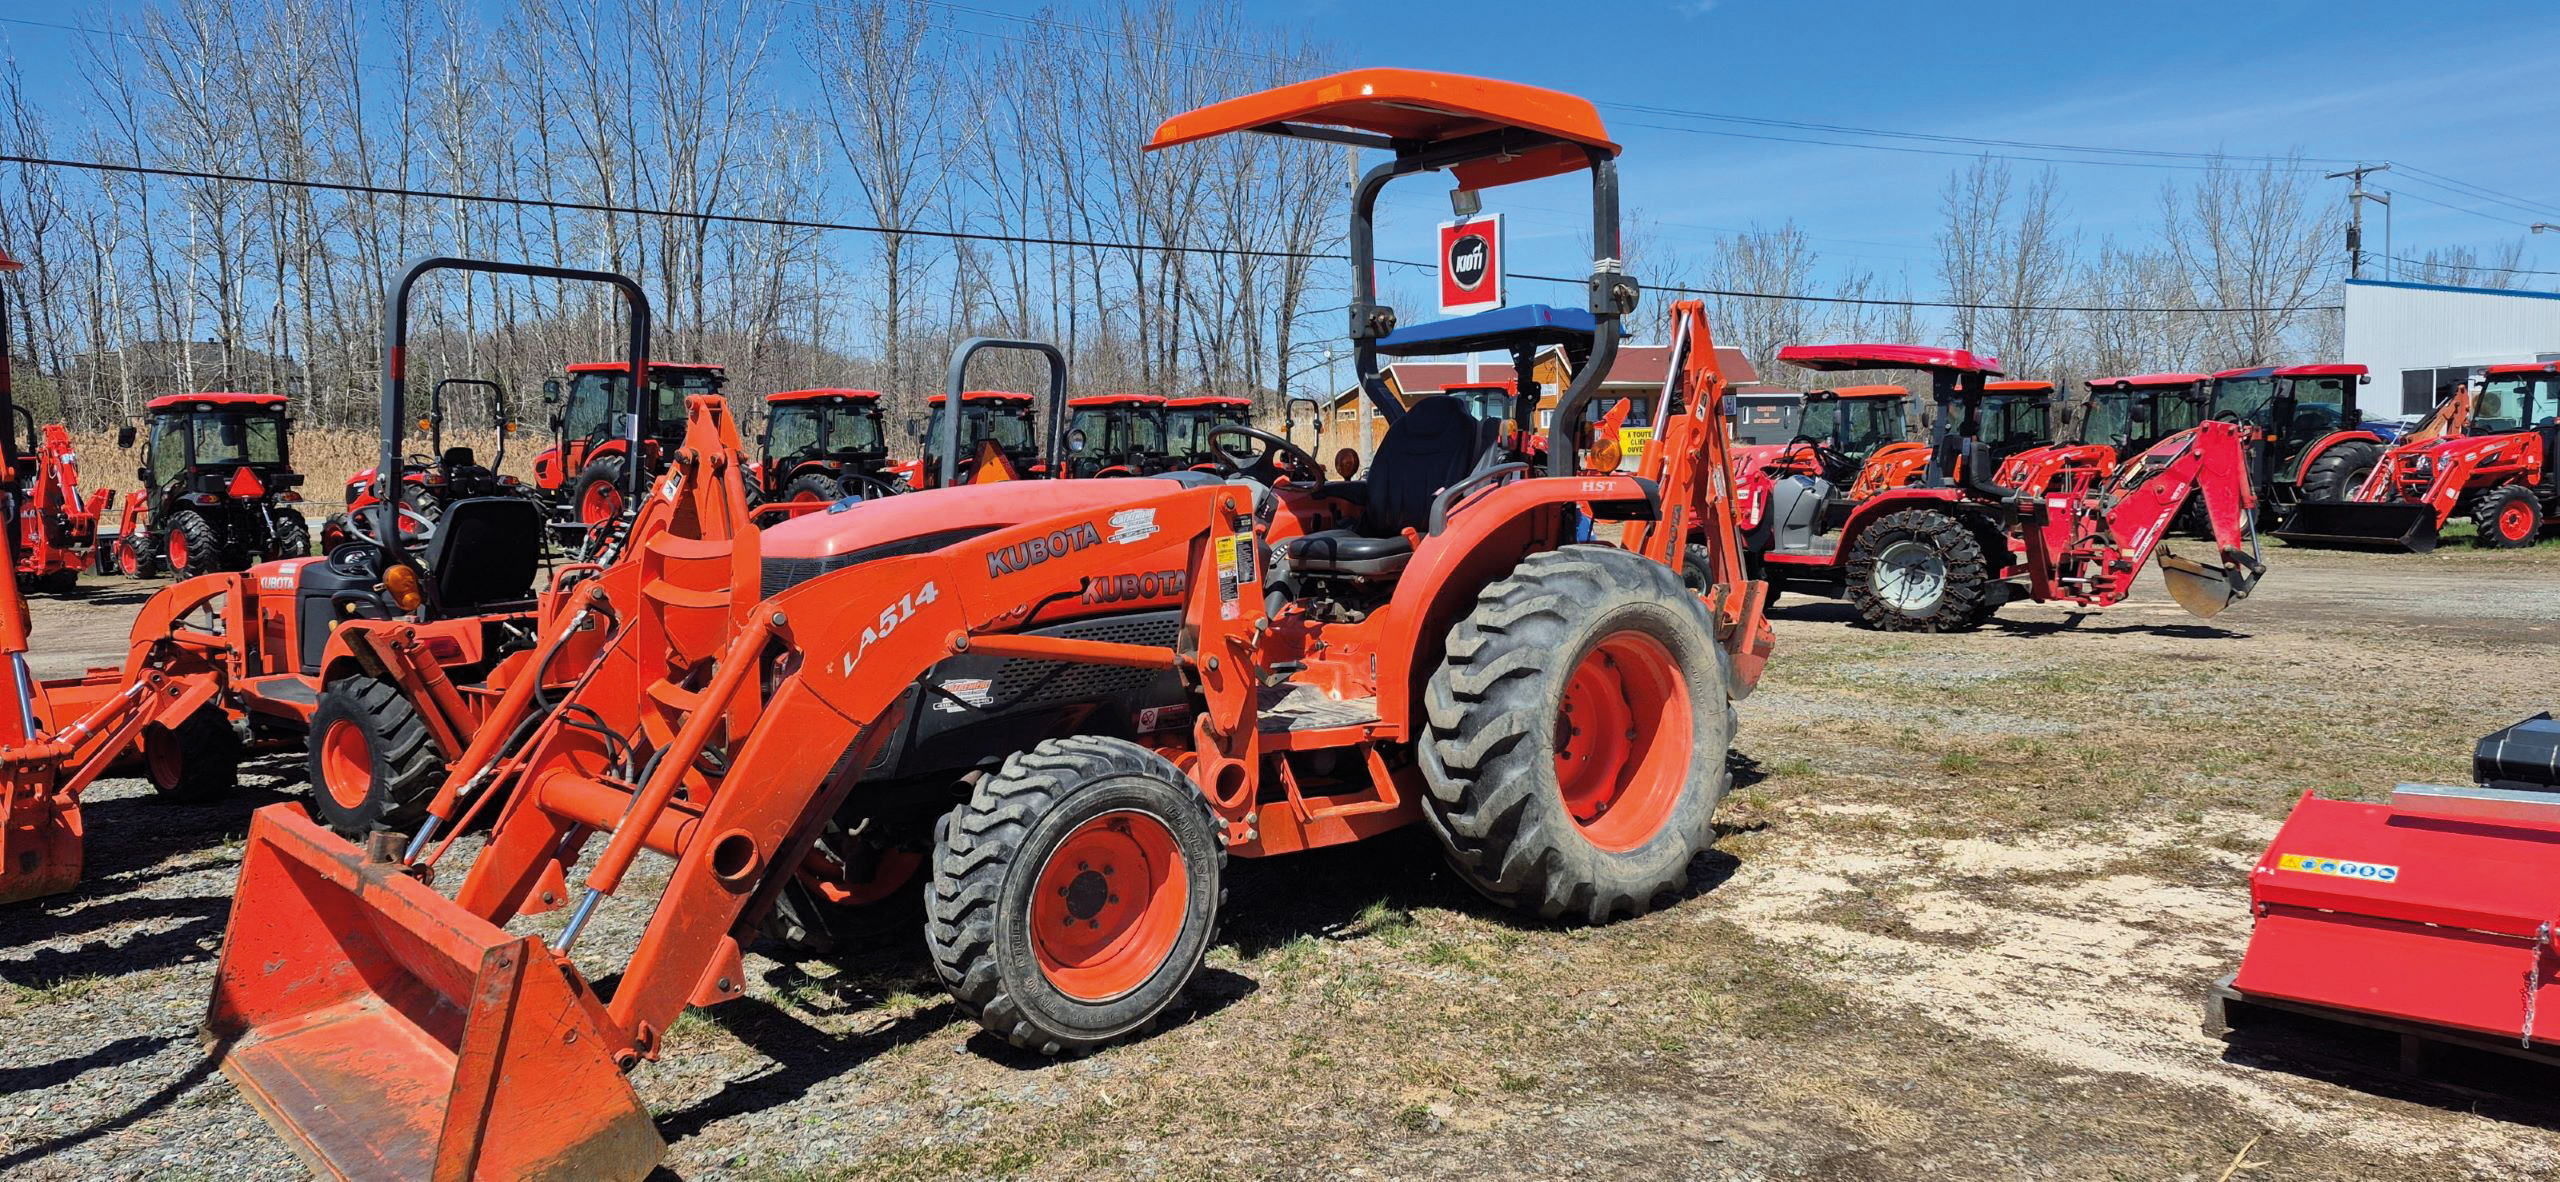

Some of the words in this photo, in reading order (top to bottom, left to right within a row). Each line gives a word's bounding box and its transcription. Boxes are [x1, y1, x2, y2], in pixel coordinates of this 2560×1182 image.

[1456, 252, 1483, 273] KIOTI
[1582, 481, 1617, 492] HST
[986, 521, 1103, 579] KUBOTA
[1081, 569, 1186, 606] KUBOTA
[843, 580, 939, 679] LA514
